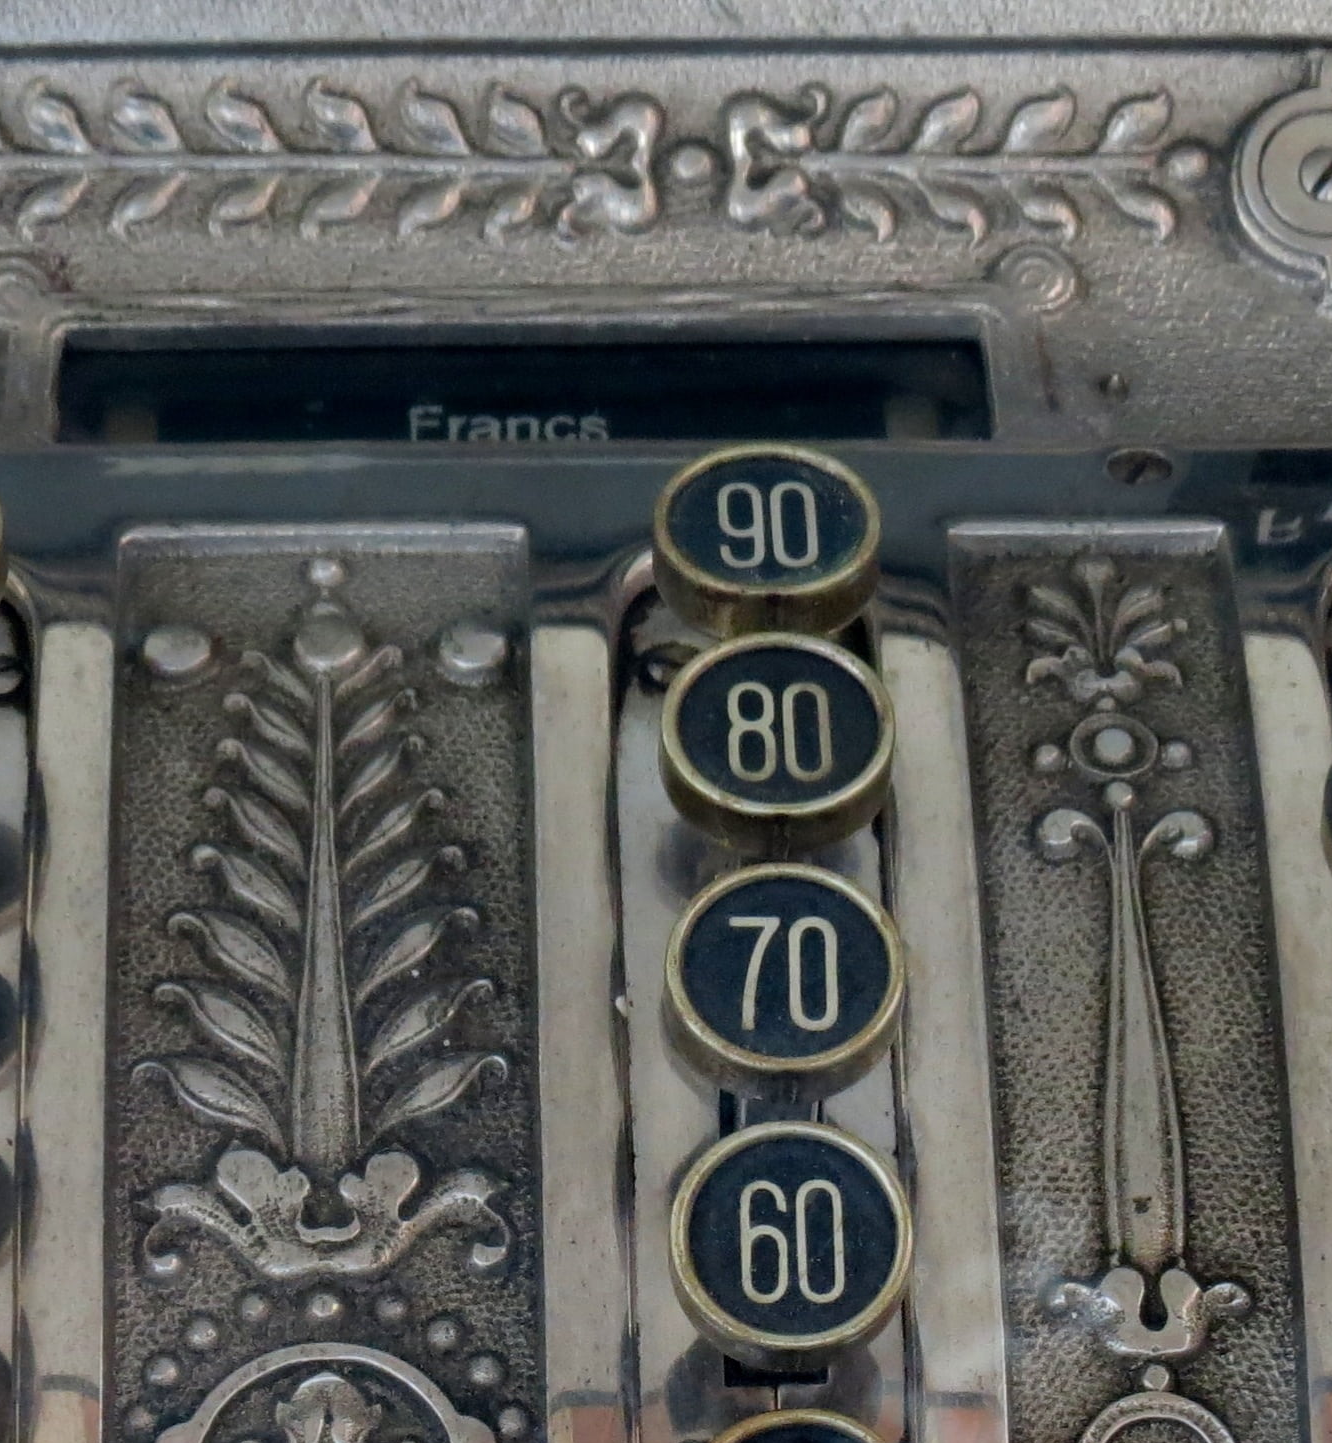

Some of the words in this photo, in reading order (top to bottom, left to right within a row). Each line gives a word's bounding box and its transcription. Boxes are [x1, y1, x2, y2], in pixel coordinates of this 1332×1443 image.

[408, 405, 608, 441] Francs
[718, 482, 818, 568] 90
[727, 682, 832, 781] 80
[729, 916, 838, 1030] 70
[740, 1179, 845, 1303] 60
